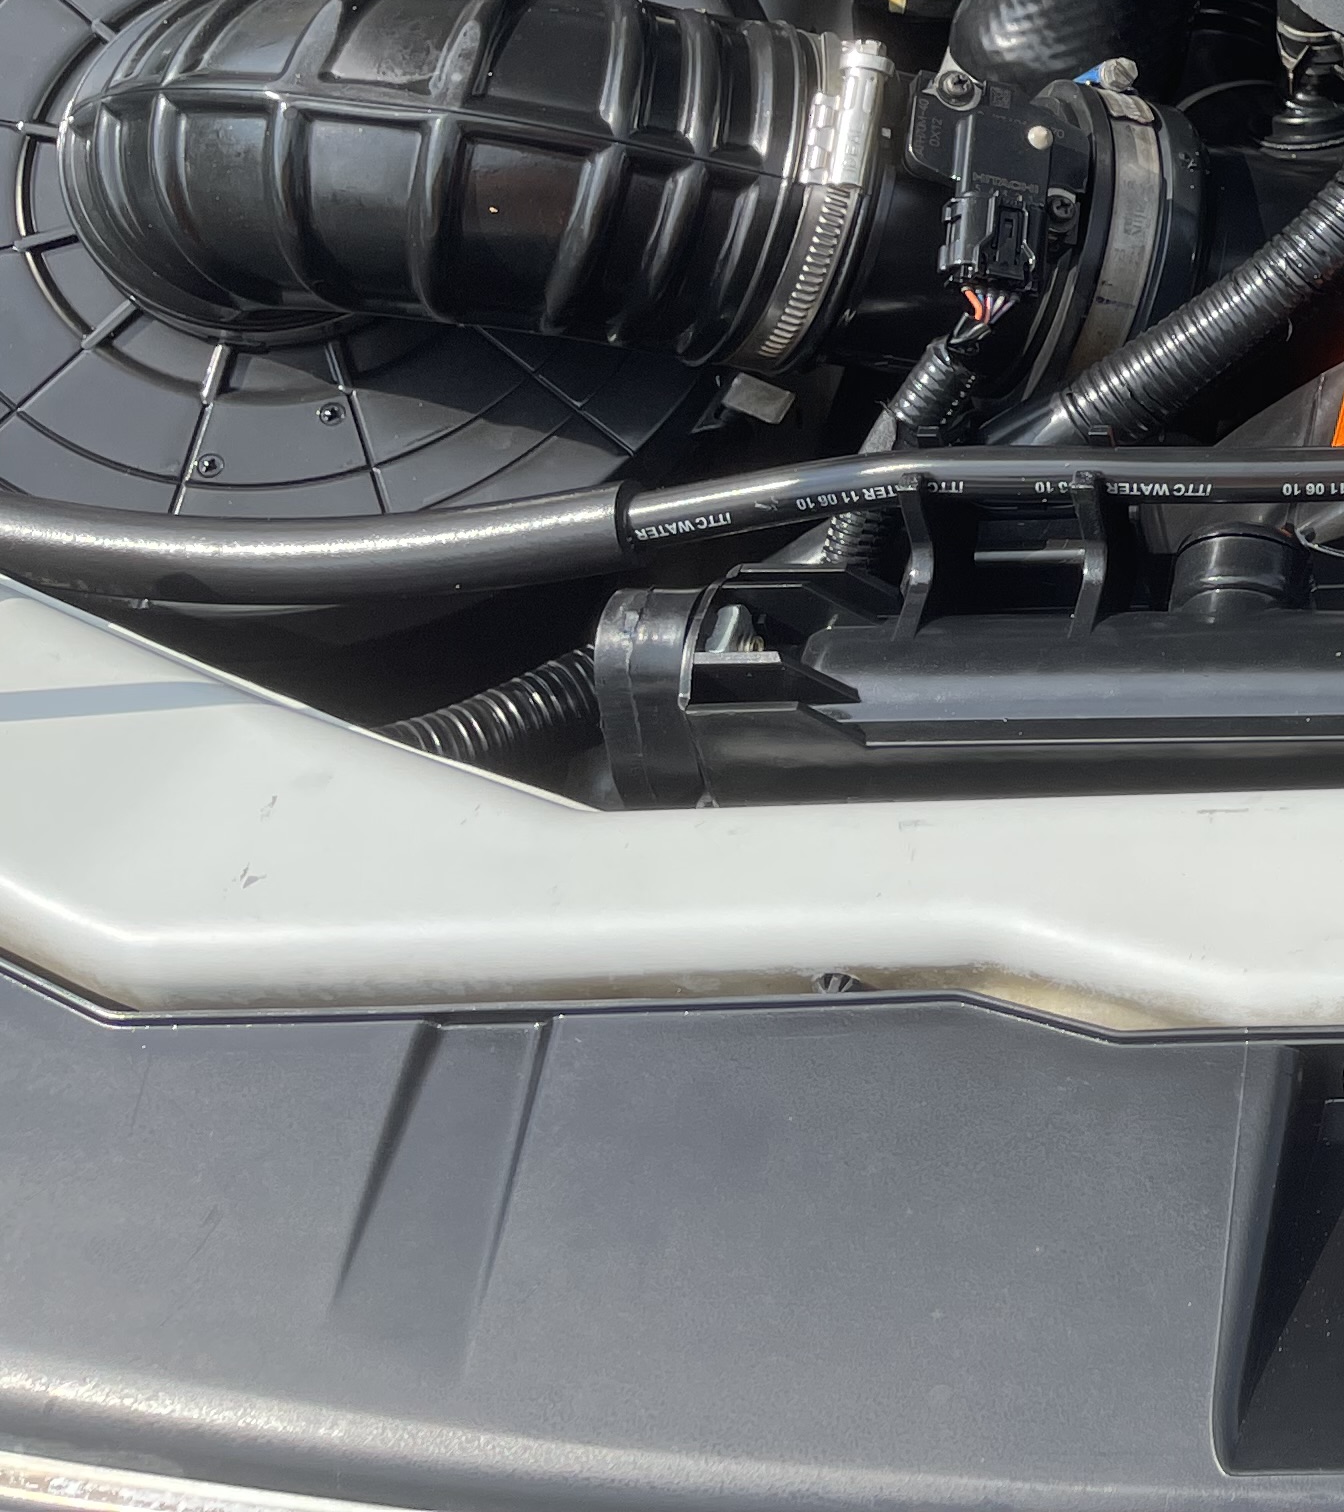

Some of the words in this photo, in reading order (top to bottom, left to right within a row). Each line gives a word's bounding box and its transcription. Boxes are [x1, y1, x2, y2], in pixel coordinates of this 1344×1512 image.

[972, 171, 1040, 195] HITACHI
[926, 480, 965, 494] ITTC
[1034, 481, 1055, 494] 10
[1105, 482, 1171, 497] WATER
[1172, 482, 1213, 497] ITTC
[1281, 483, 1300, 497] 10
[1304, 483, 1326, 496] 06
[795, 497, 816, 512] 10
[816, 493, 839, 509] 06
[843, 489, 860, 505] 11
[692, 511, 733, 531] ITTC
[635, 519, 694, 541] WATER
